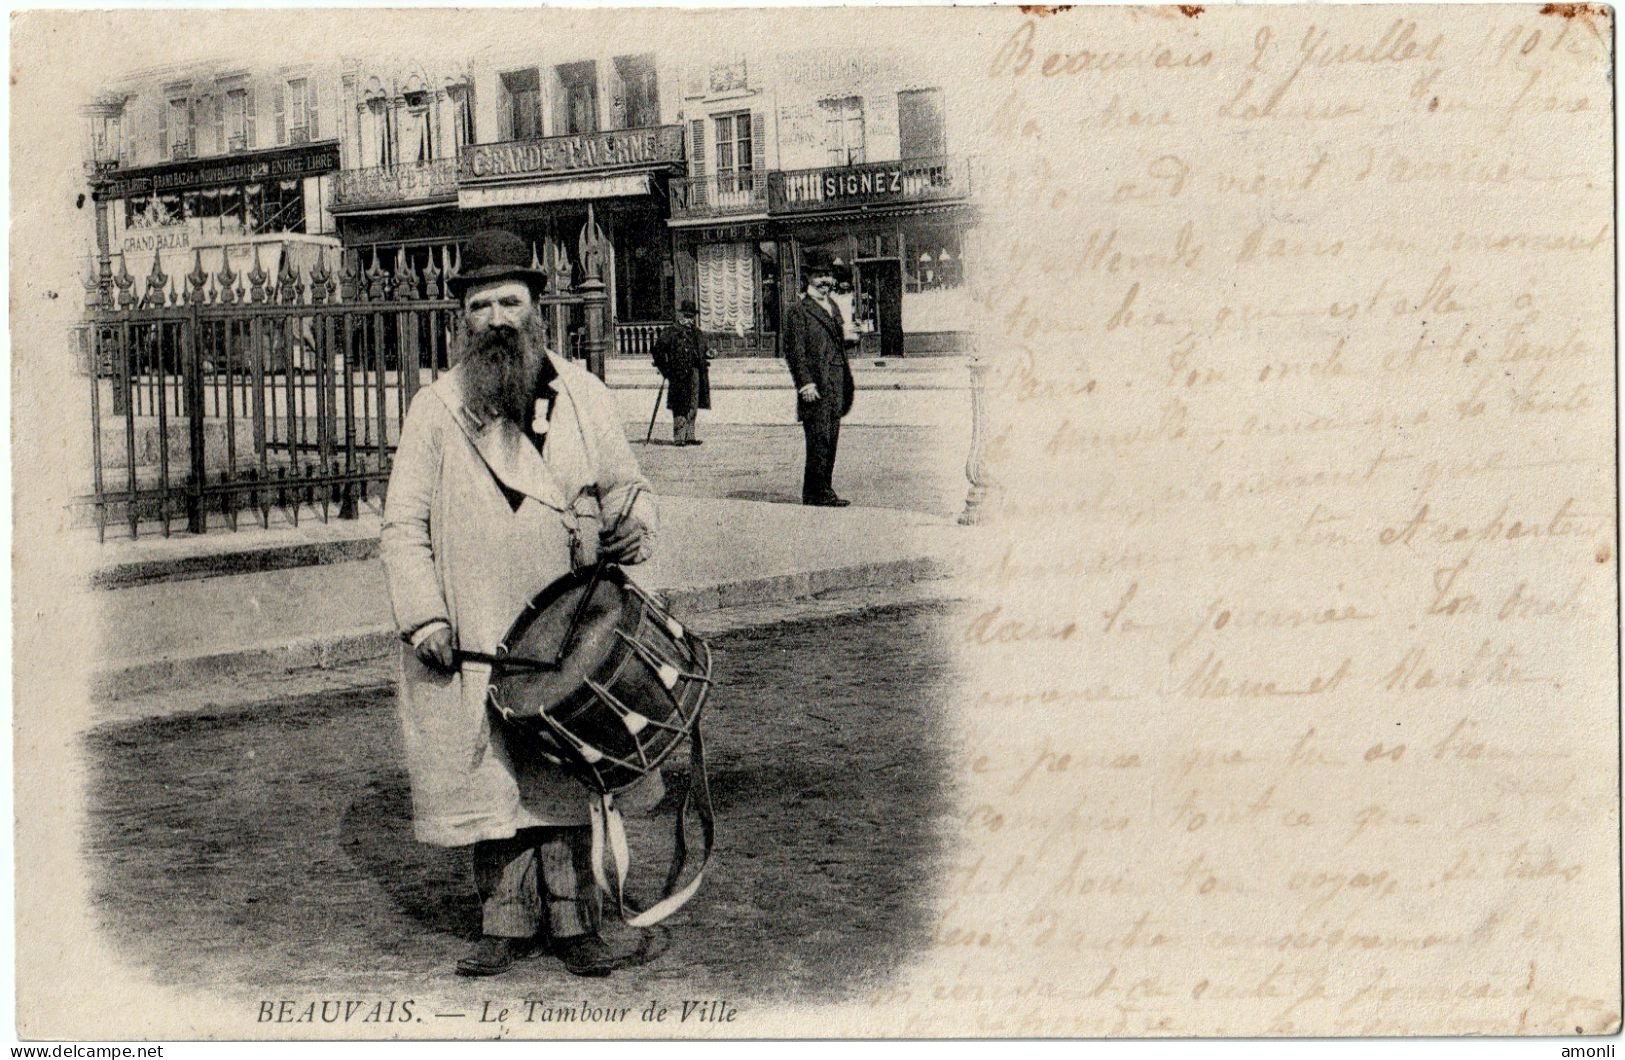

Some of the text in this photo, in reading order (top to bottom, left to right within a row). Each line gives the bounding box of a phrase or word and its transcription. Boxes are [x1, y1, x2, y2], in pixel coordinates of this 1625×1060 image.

[988, 19, 1212, 78] Beauvais
[826, 171, 901, 198] SIGNEZ
[124, 232, 190, 251] GRAND BAZAR
